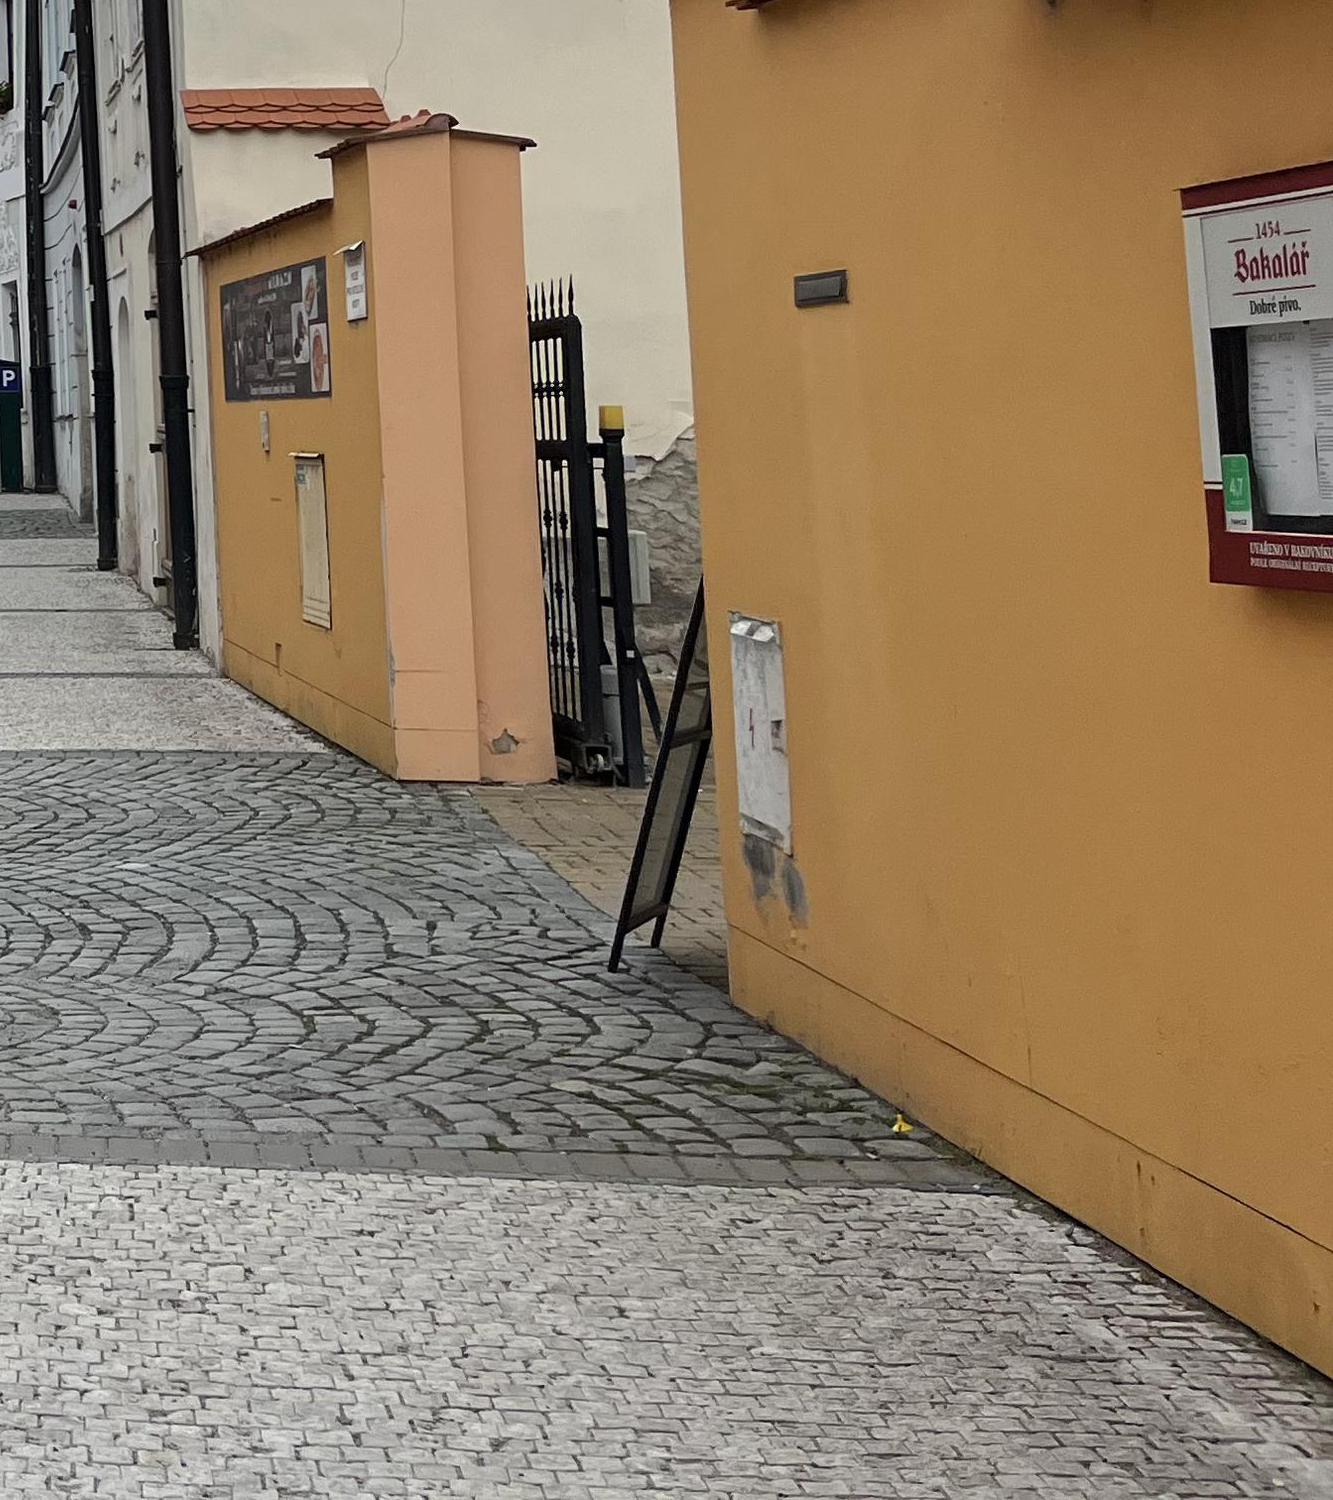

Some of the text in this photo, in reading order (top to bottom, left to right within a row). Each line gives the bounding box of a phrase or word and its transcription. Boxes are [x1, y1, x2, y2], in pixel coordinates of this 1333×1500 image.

[1255, 220, 1280, 239] 1454
[1234, 241, 1310, 283] Bakalář
[1249, 295, 1302, 317] Dobré pivo.
[2, 369, 16, 387] P
